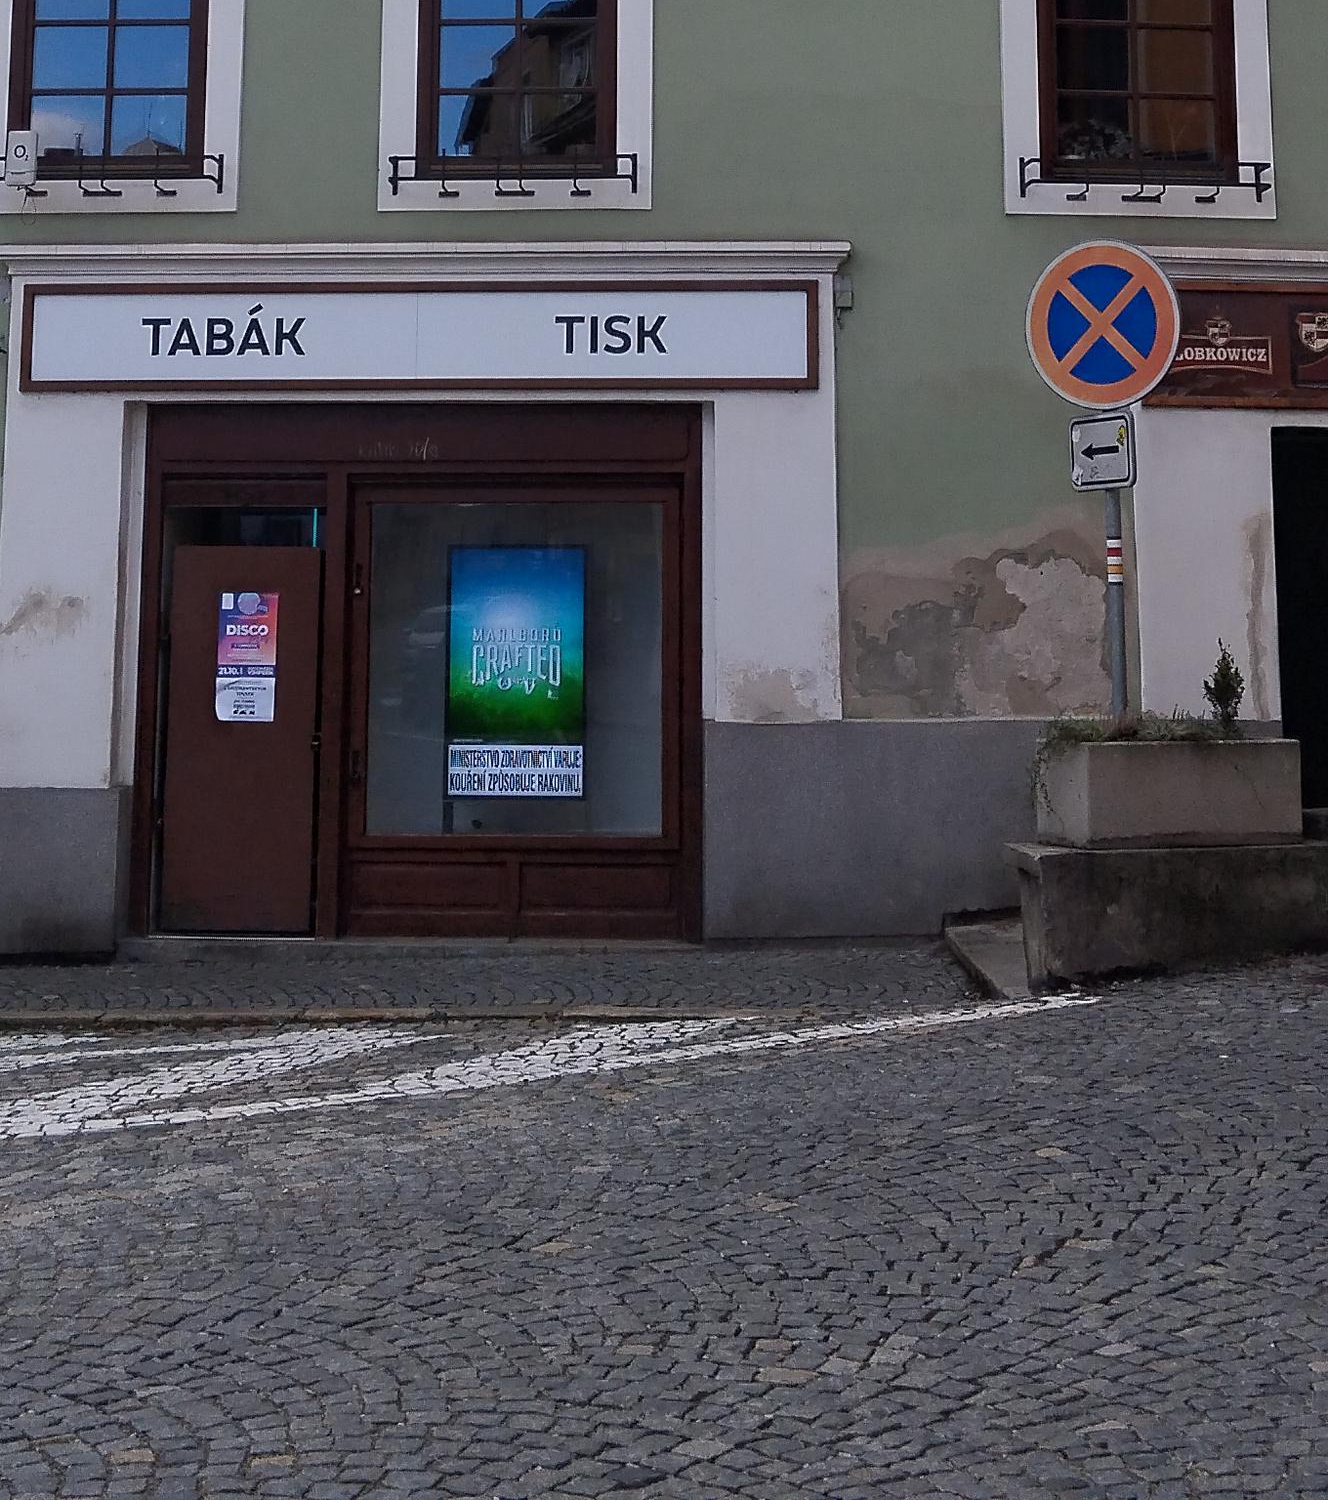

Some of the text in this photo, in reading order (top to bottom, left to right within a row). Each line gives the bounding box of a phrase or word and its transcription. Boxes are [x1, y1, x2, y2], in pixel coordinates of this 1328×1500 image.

[142, 303, 668, 357] TABÁK TISK
[226, 624, 269, 636] DISCO
[472, 627, 561, 642] MARLBORO
[471, 644, 561, 687] CRAFTED
[450, 749, 499, 768] MINISTERSTVO
[500, 747, 553, 768] ZDRAVOTNICTVÍ
[449, 770, 487, 791] KOUŘENÍ
[487, 770, 536, 792] ZPŮSOBUJE
